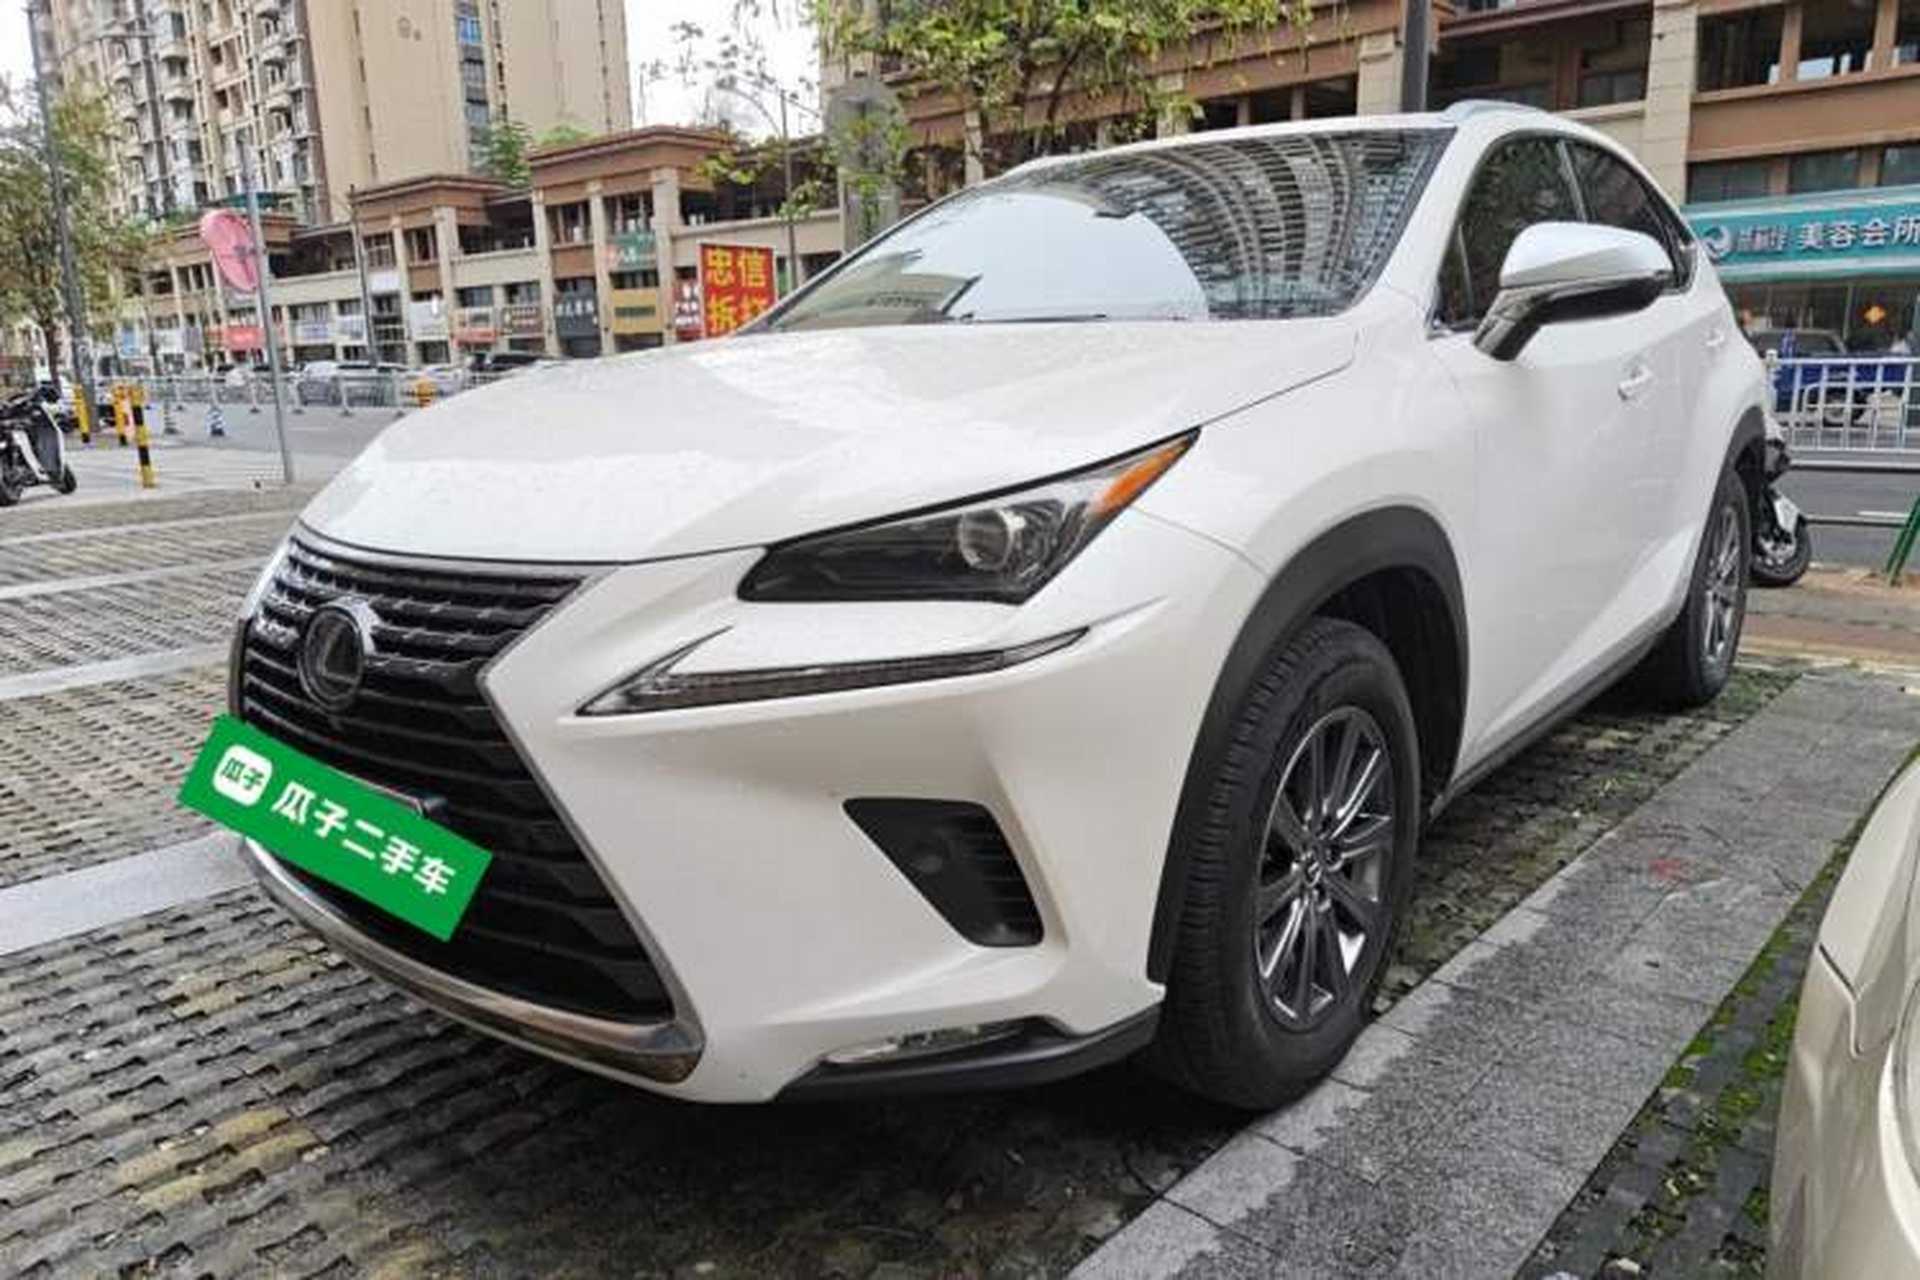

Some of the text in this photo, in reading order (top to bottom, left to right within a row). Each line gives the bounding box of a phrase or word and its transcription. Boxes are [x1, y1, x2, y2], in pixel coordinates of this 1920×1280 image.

[1800, 215, 1920, 250] 美容会所
[705, 248, 767, 288] 忠信
